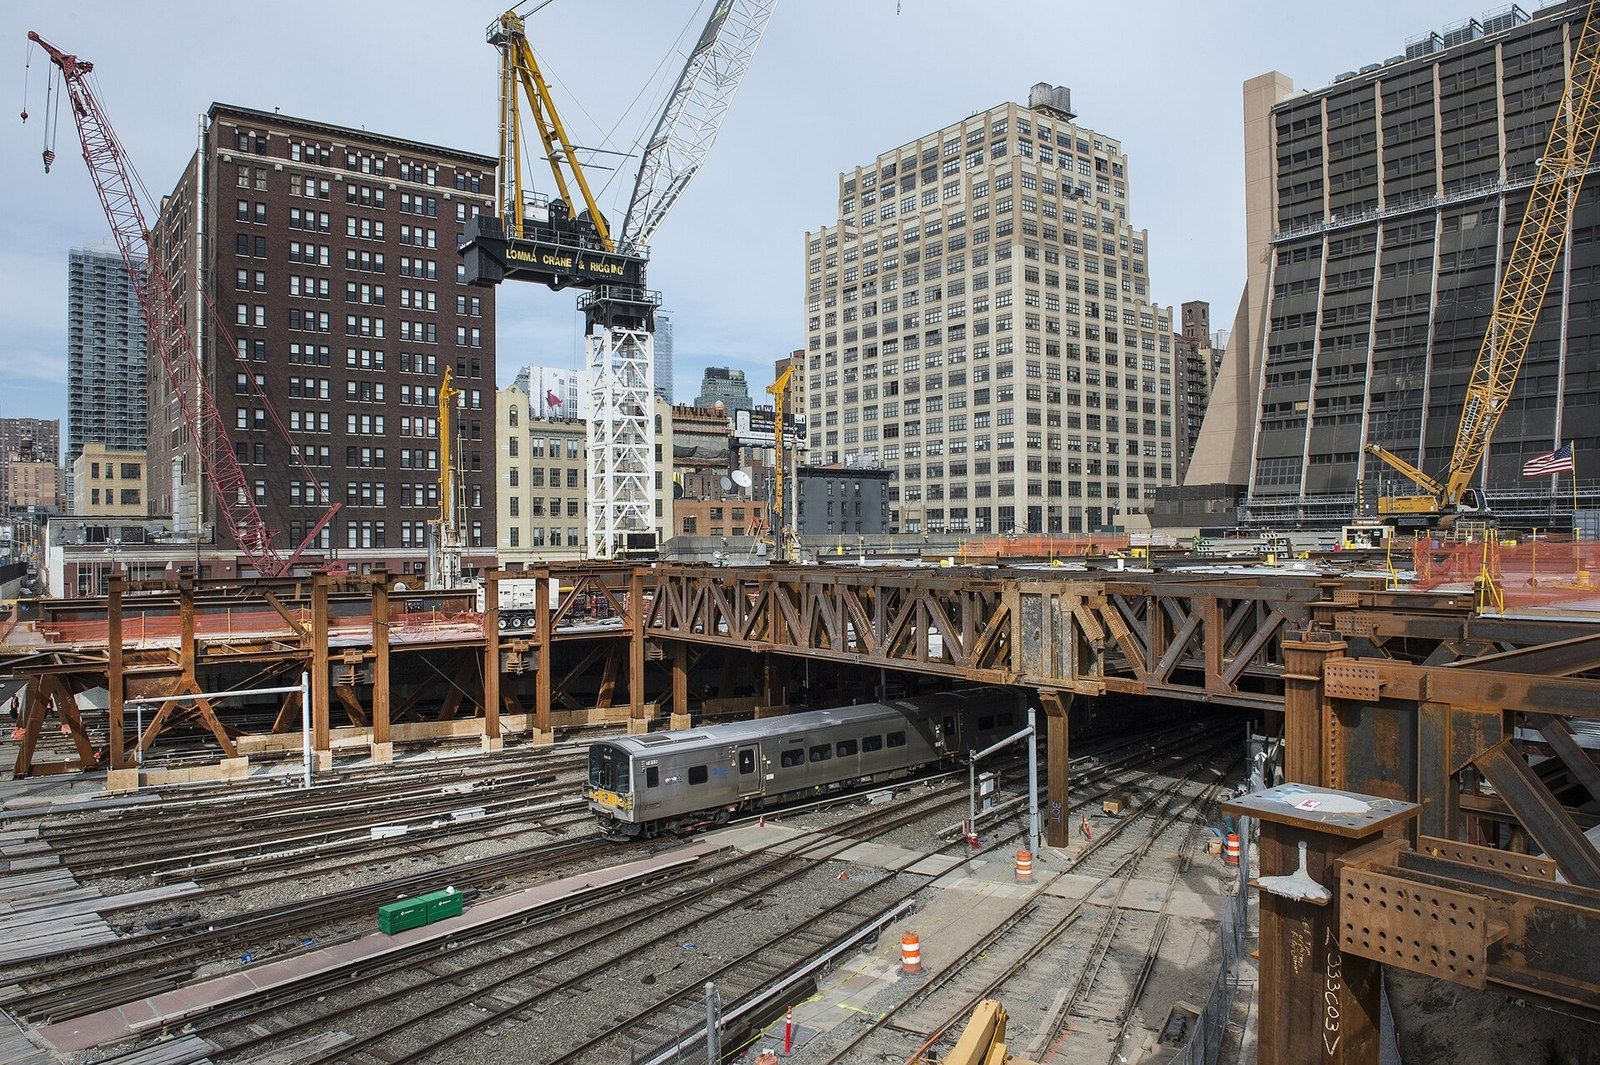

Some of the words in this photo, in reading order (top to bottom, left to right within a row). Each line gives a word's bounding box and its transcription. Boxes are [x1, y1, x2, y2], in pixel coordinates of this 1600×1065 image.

[506, 249, 537, 263] LOMMA
[543, 254, 572, 267] CRANE
[578, 260, 585, 270] &
[591, 261, 624, 275] RIGGING
